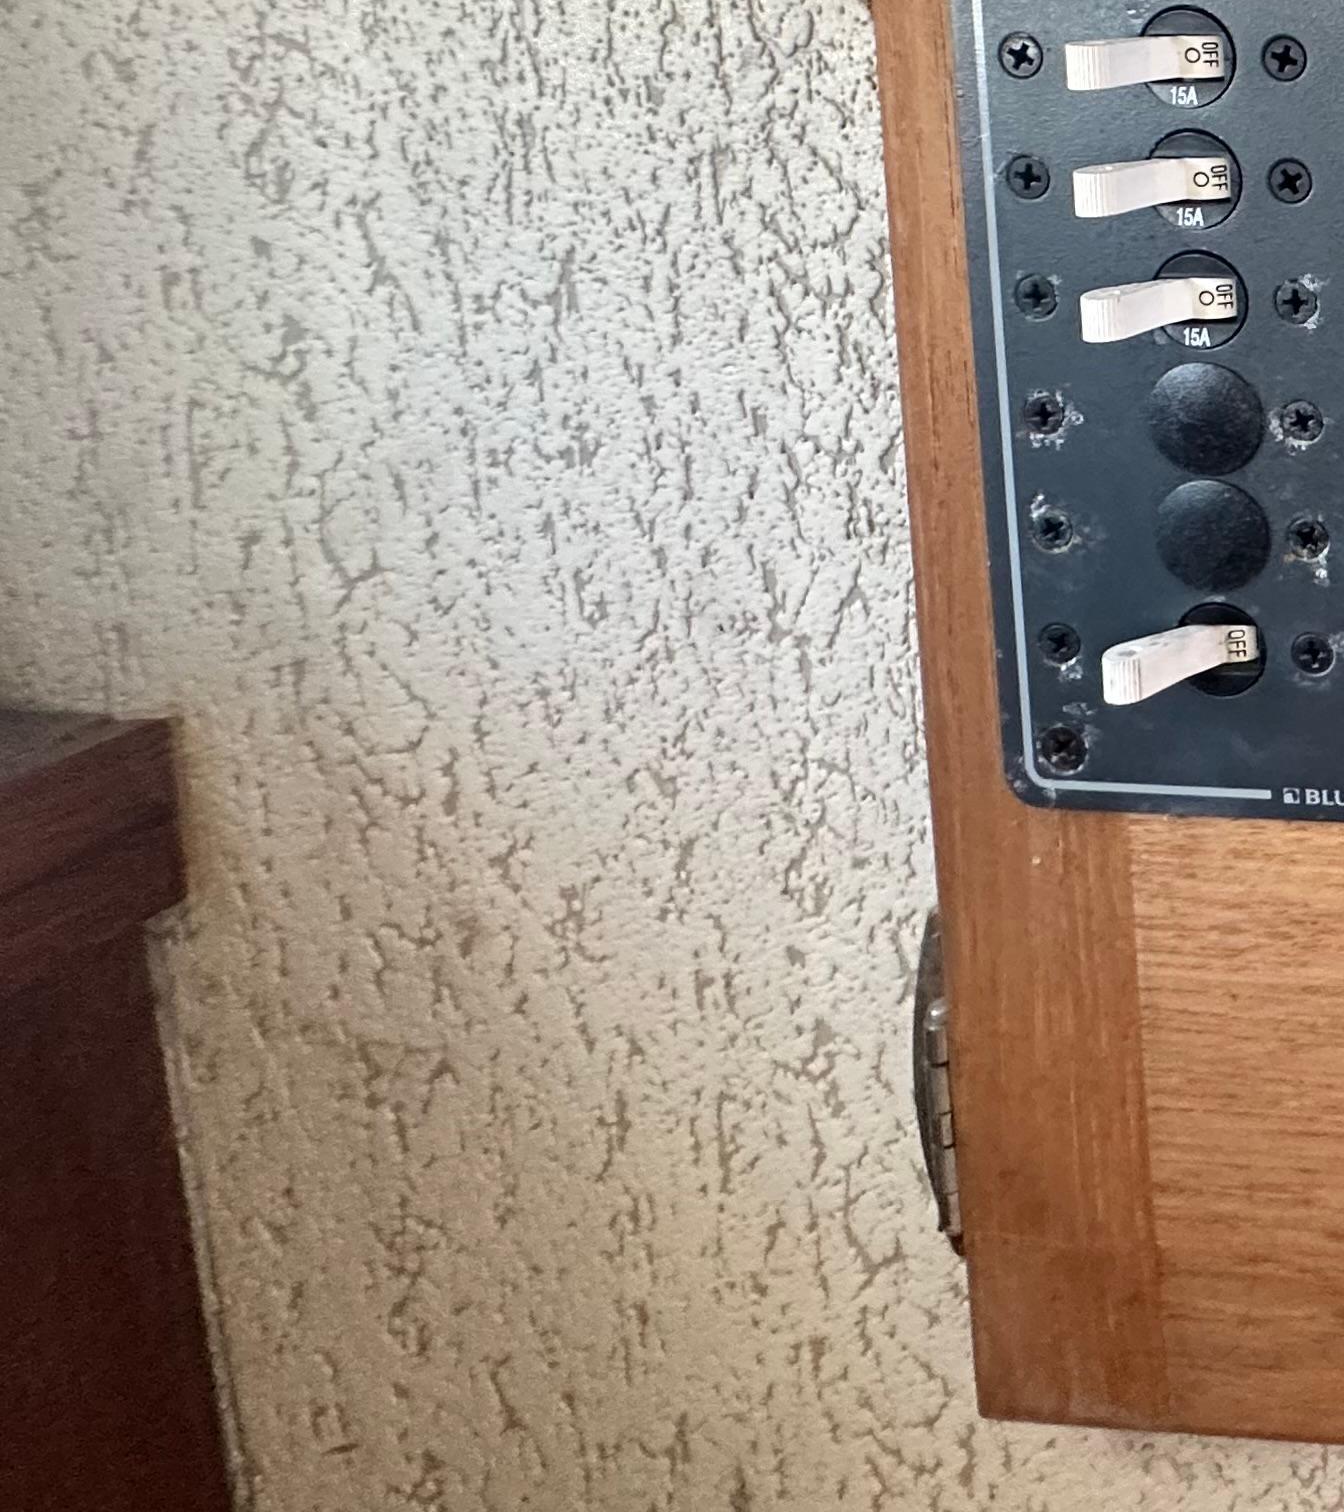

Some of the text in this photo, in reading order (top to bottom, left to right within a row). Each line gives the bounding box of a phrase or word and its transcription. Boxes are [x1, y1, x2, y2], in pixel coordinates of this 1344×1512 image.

[1201, 42, 1219, 68] OFF
[1170, 87, 1197, 105] 15A
[1210, 165, 1228, 191] OFF
[1176, 207, 1203, 226] 15A
[1216, 284, 1233, 309] OFF
[1183, 328, 1210, 346] 15A
[1227, 628, 1247, 659] OFF
